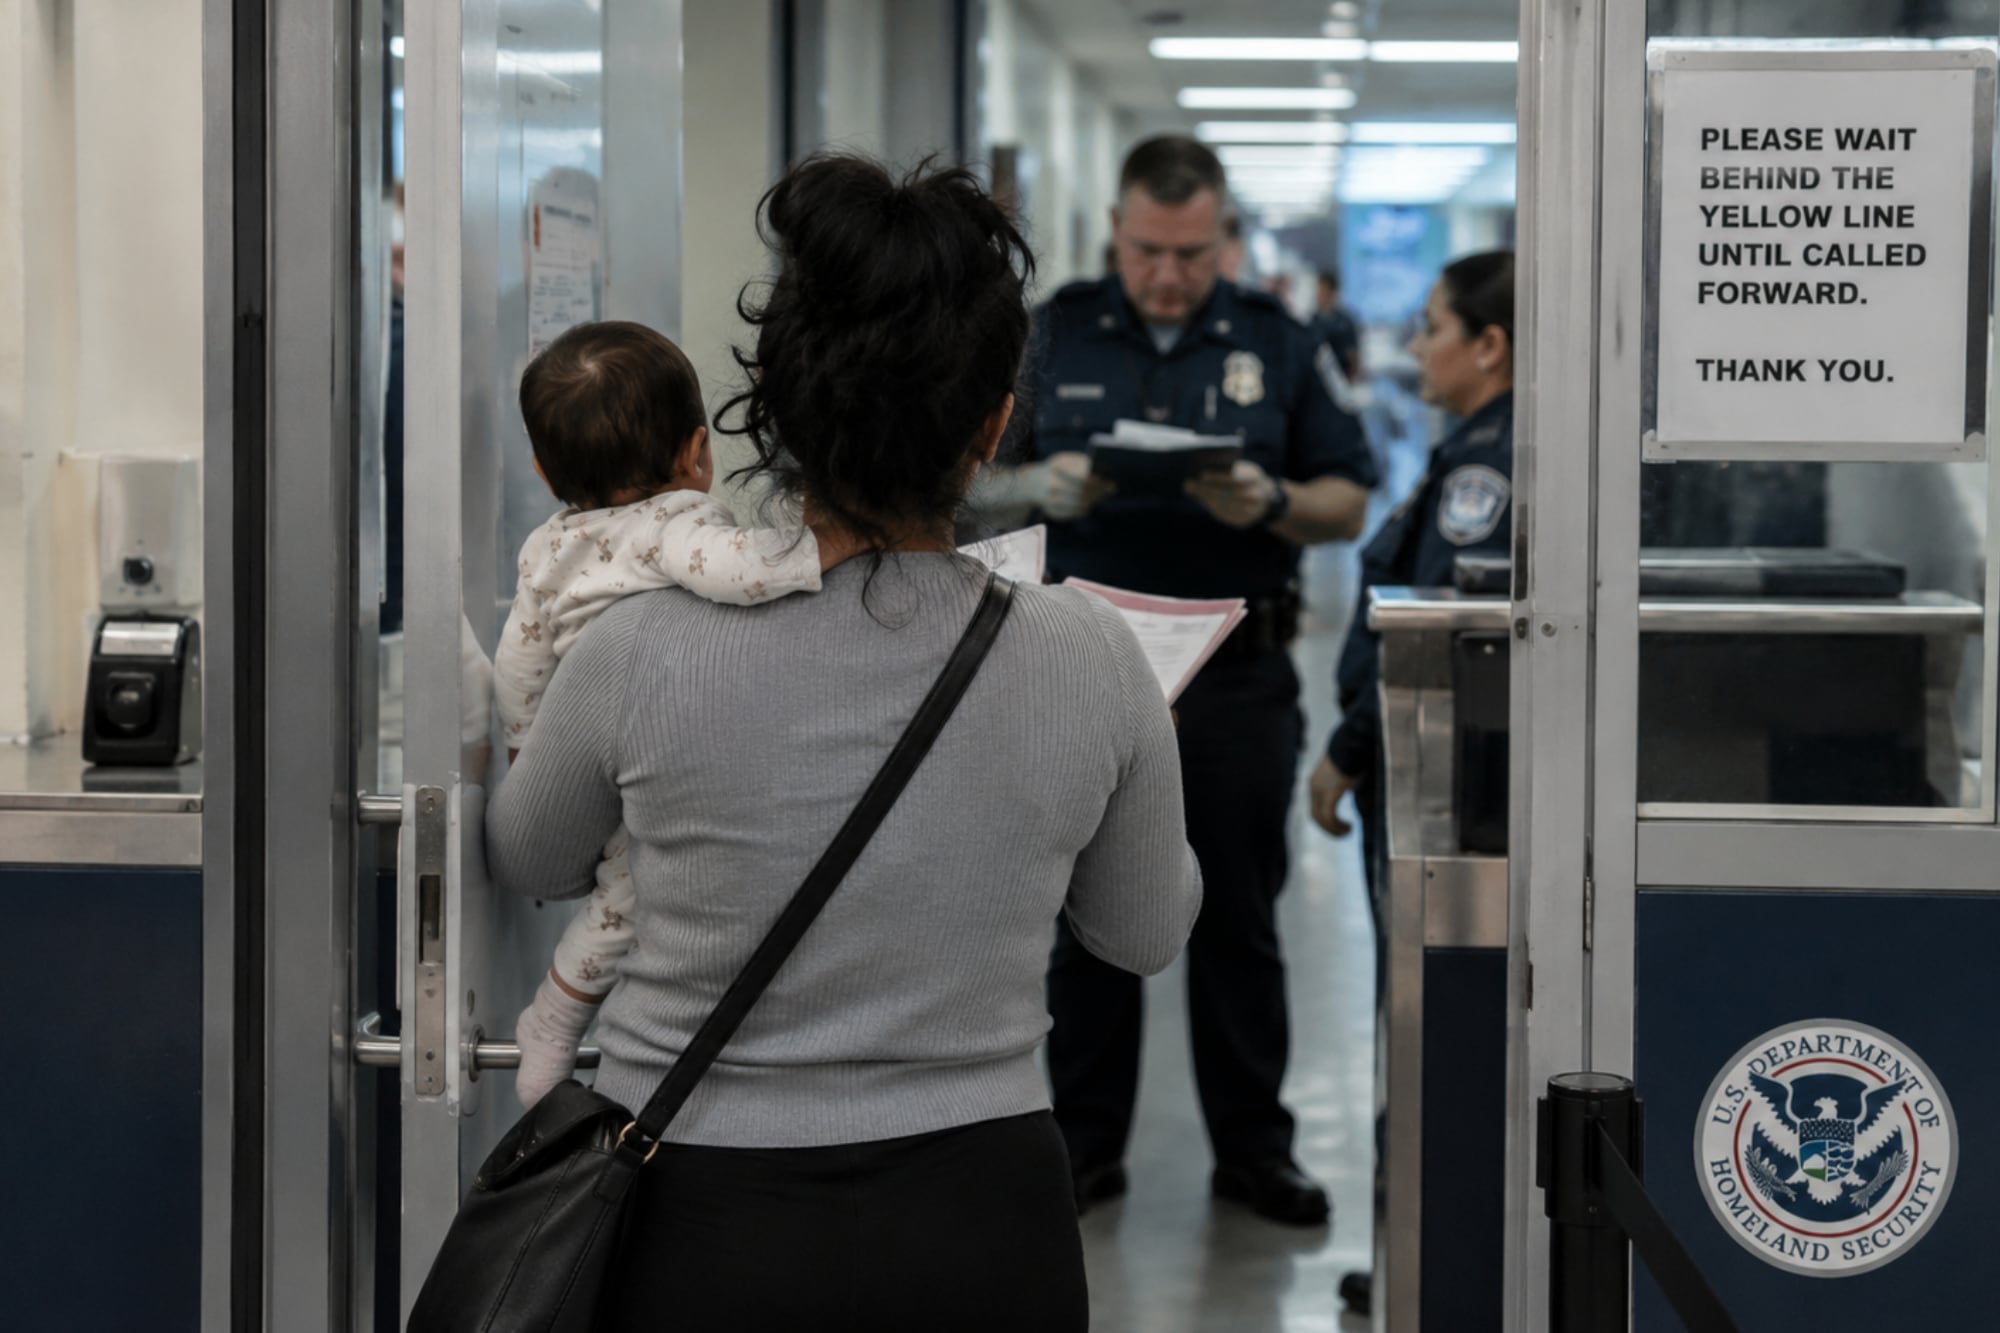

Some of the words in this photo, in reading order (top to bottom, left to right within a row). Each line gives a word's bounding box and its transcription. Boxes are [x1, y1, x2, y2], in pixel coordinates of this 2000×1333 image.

[1700, 127, 1824, 151] PLEASE
[1834, 127, 1918, 151] WAIT
[1699, 166, 1821, 190] BEHIND
[1832, 166, 1895, 190] THE
[1698, 204, 1833, 229] YELLOW
[1843, 205, 1916, 229] LINE
[1698, 243, 1793, 267] UNTIL
[1802, 243, 1927, 267] CALLED
[1698, 281, 1868, 305] FORWARD.
[1695, 358, 1807, 383] THANK
[1816, 358, 1895, 383] YOU.
[1711, 1083, 1750, 1127] U.S.
[1746, 1034, 1924, 1094] DEPARTMENT
[1913, 1097, 1941, 1130] OF
[1709, 1157, 1830, 1262] HOMELAND
[1842, 1160, 1941, 1261] SECURITY
